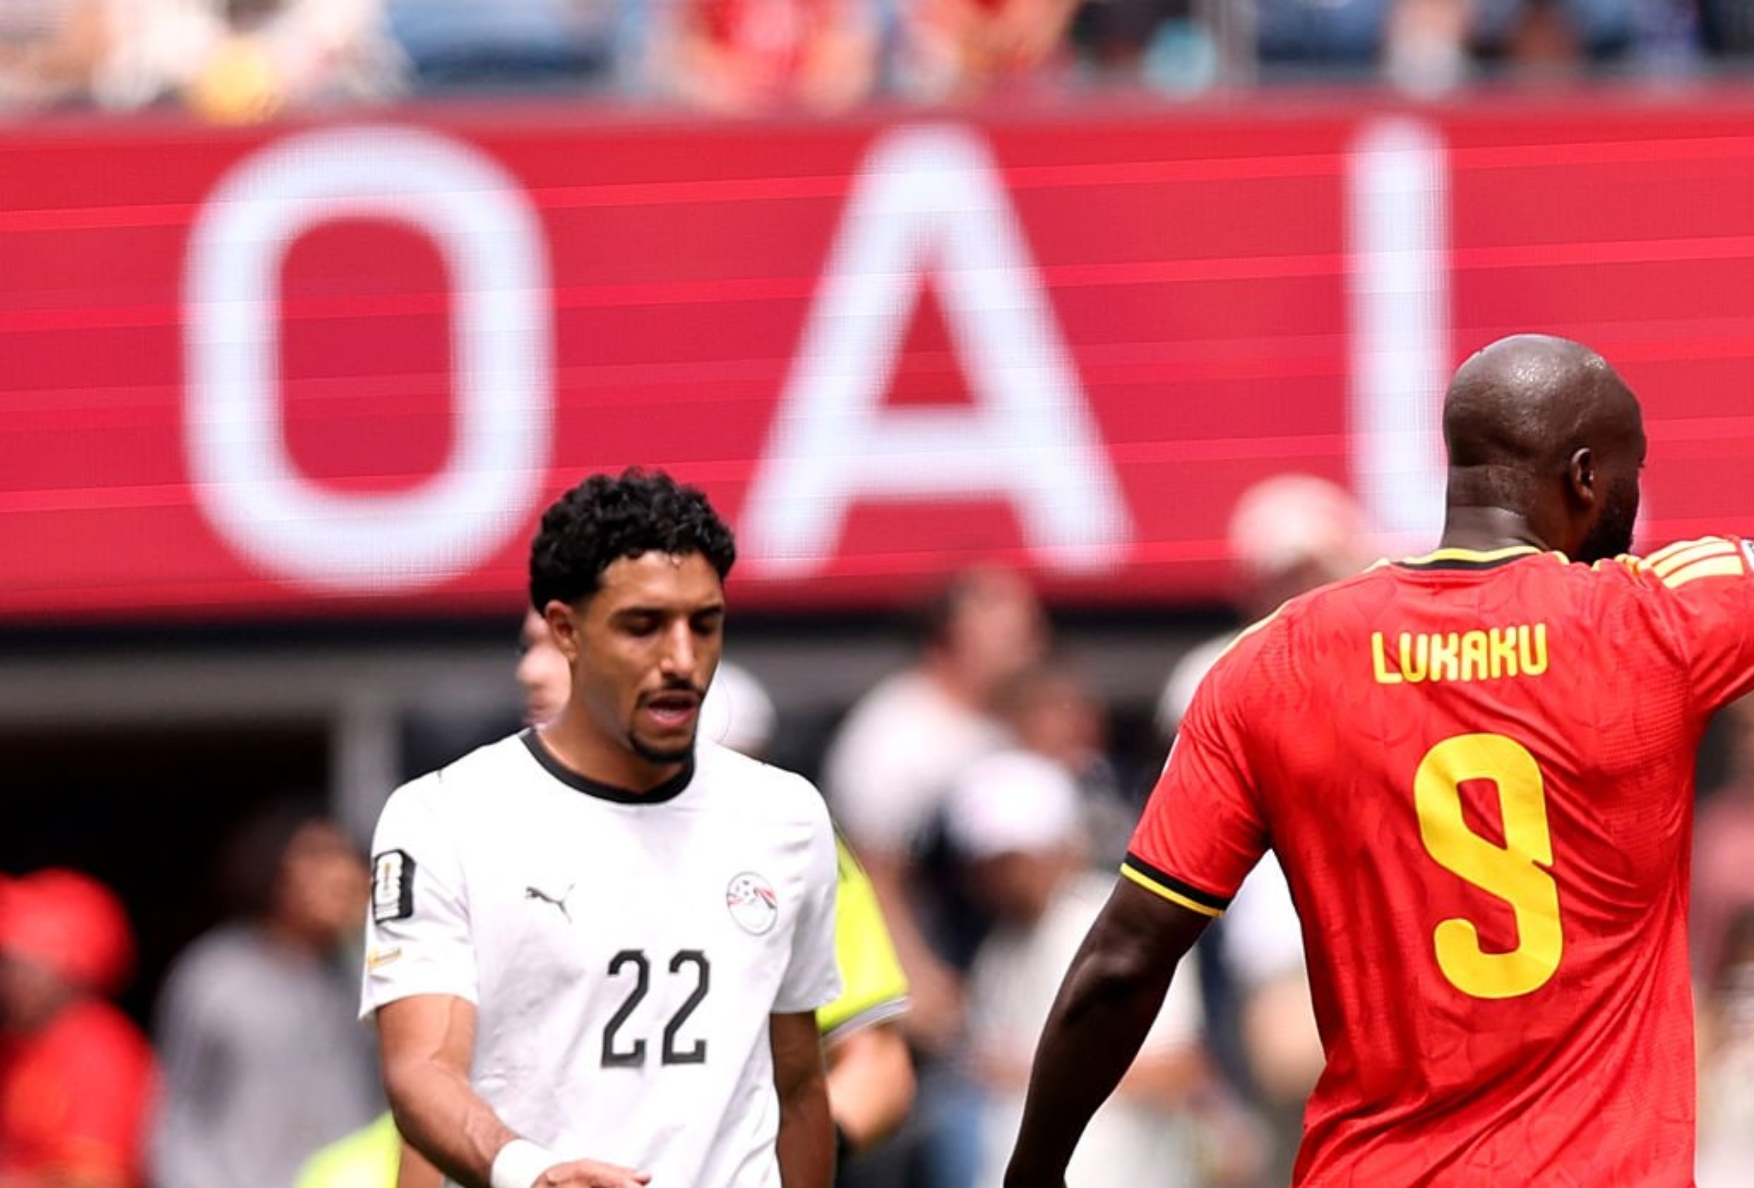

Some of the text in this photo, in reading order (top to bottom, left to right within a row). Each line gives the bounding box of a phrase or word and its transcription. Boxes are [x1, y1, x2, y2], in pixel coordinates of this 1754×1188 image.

[1371, 623, 1548, 683] LUKAKU
[1414, 732, 1563, 998] 9
[600, 949, 710, 1068] 22
